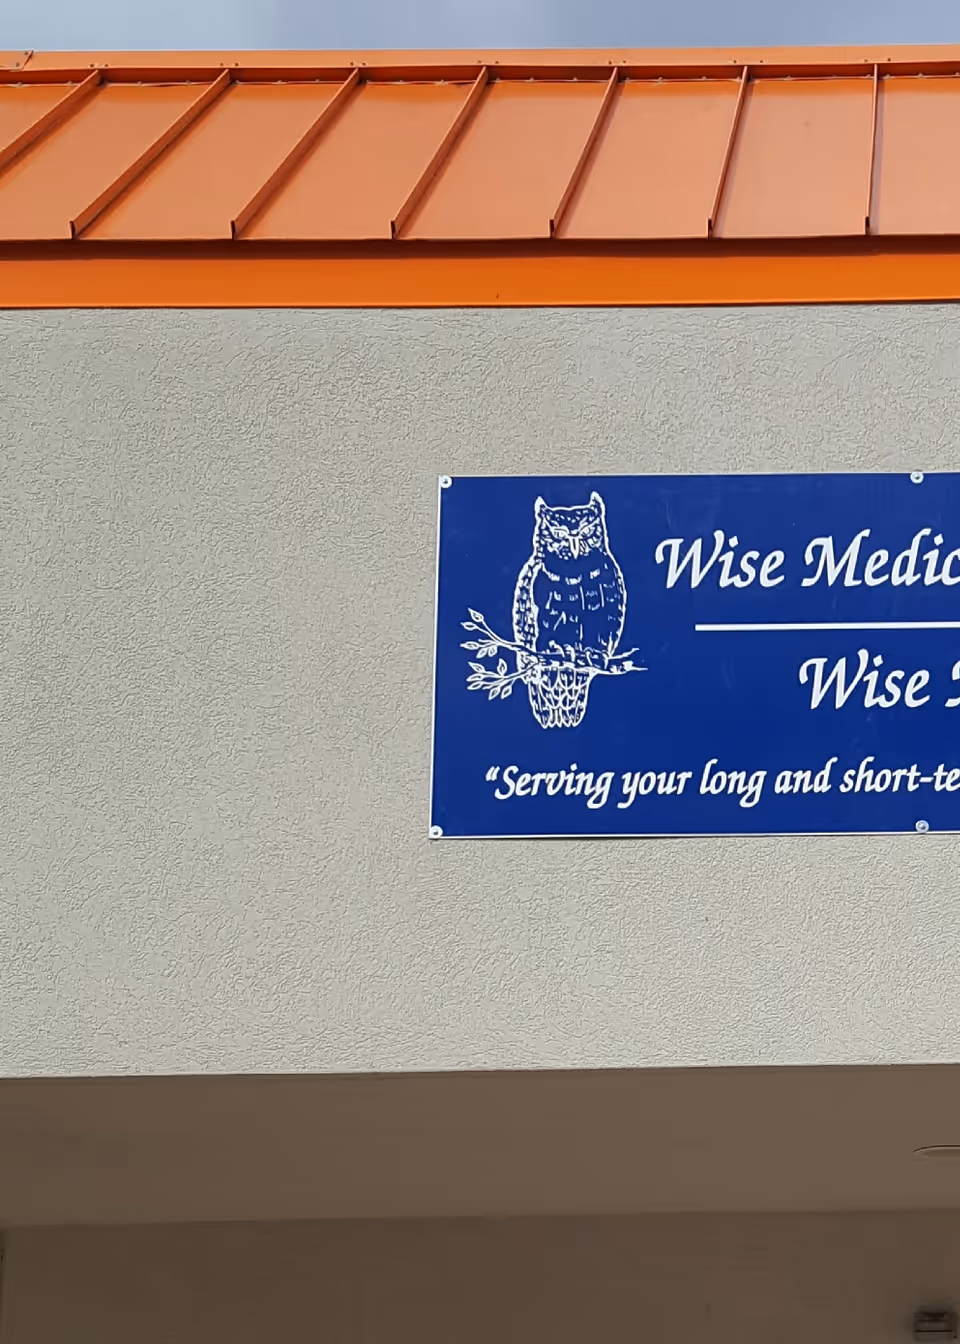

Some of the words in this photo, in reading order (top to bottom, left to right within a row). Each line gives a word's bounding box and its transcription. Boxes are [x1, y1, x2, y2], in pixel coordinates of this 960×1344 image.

[654, 529, 785, 589] Wise
[798, 648, 930, 710] Wise
[617, 771, 693, 809] your
[699, 758, 768, 808] long
[774, 756, 839, 794] and
